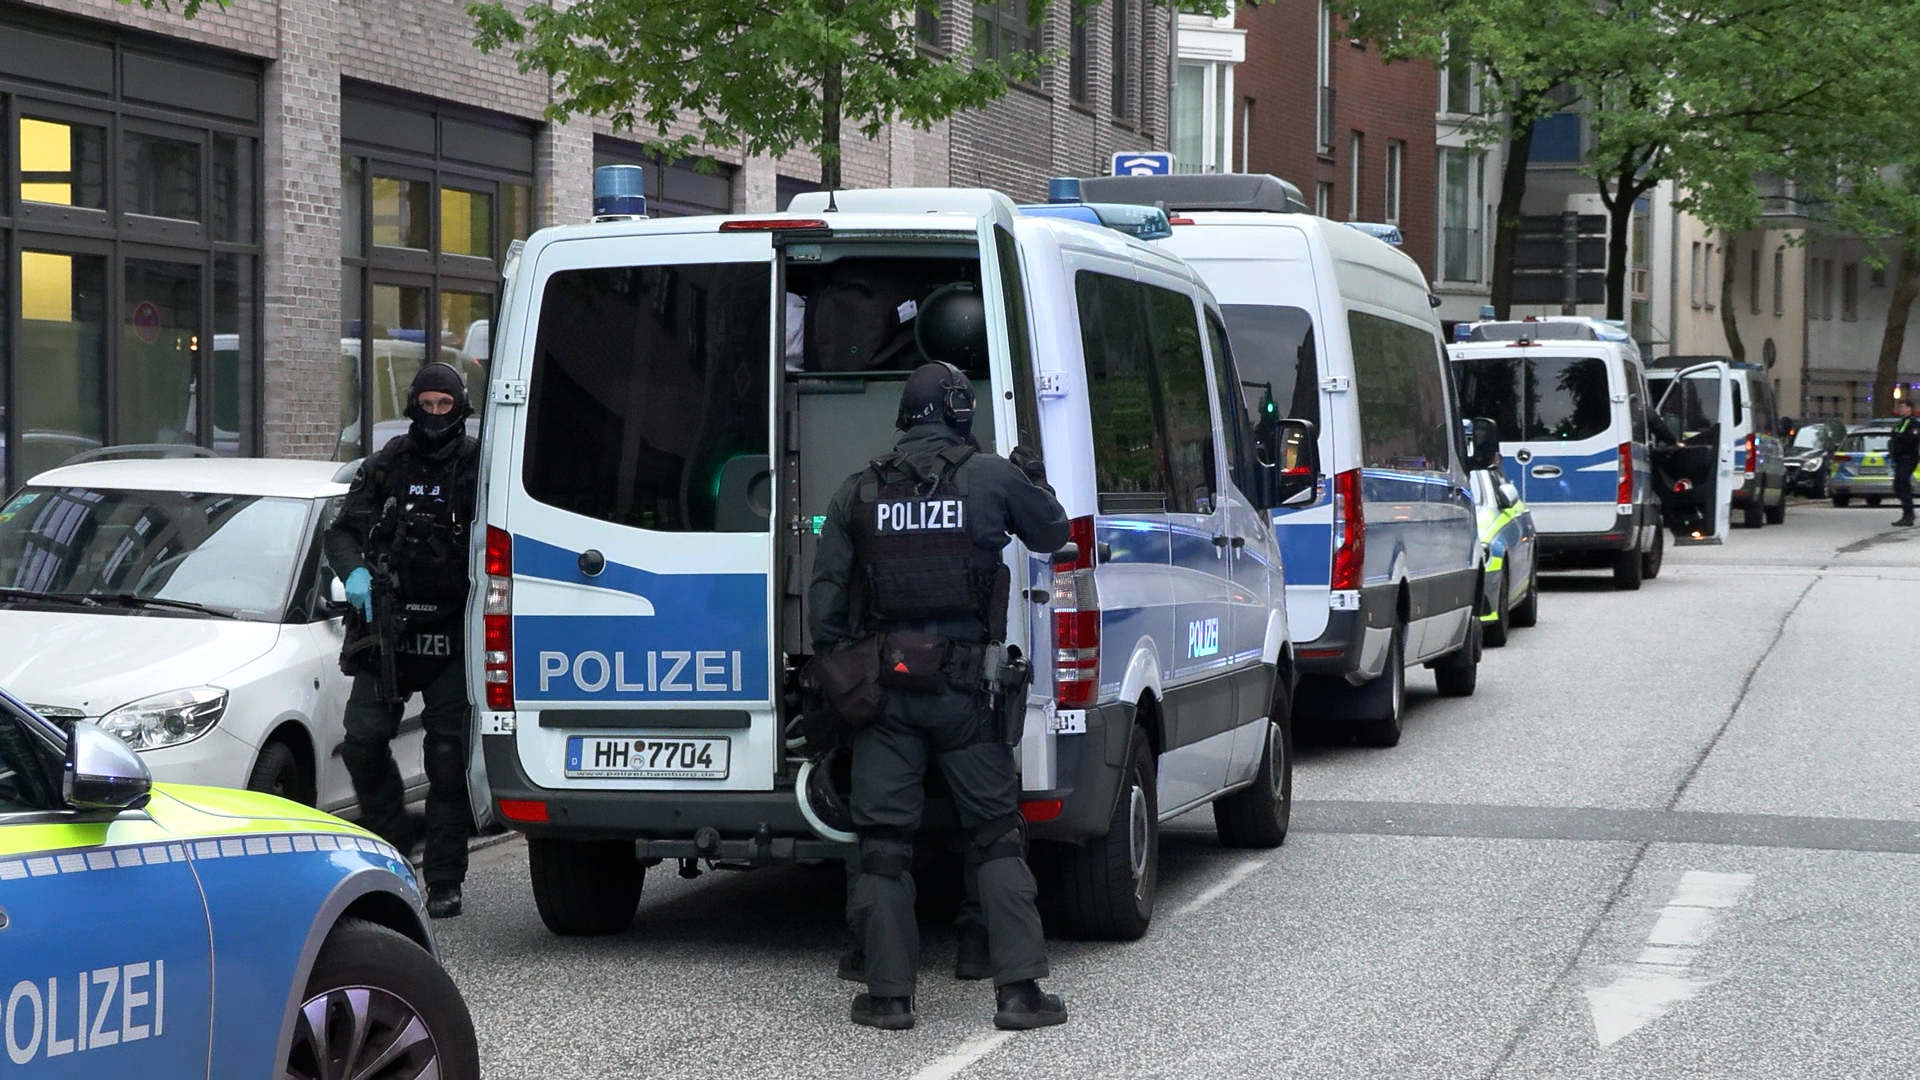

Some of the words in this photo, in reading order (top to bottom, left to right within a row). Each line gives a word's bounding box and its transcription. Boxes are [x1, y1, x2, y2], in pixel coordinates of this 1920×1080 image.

[877, 500, 963, 532] POLIZEI
[405, 603, 438, 612] POLIZEI
[396, 633, 451, 656] LIZEI
[1188, 617, 1219, 659] POLIZEI
[539, 650, 742, 692] POLIZEI
[571, 757, 579, 766] D
[594, 741, 630, 768] HH
[647, 742, 713, 769] 7704
[577, 770, 716, 778] www.polizei.hamburg.de
[0, 959, 164, 1065] OLIZEI
